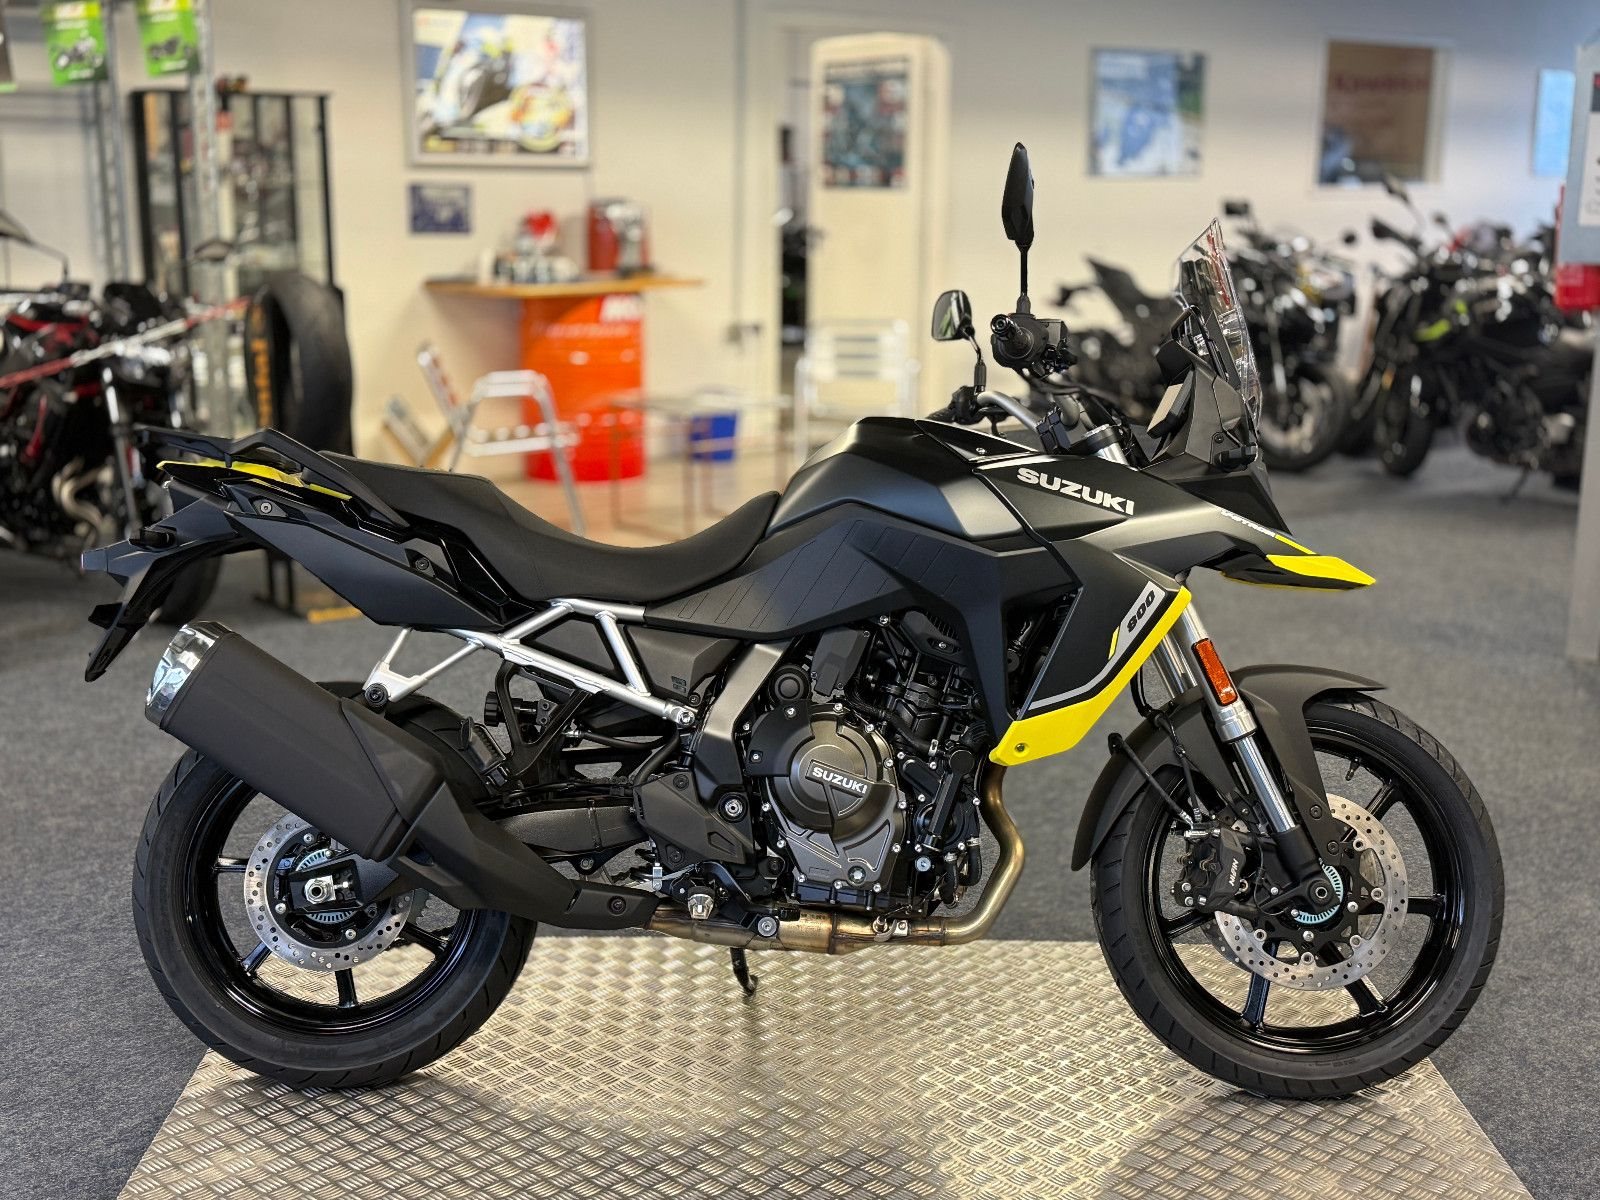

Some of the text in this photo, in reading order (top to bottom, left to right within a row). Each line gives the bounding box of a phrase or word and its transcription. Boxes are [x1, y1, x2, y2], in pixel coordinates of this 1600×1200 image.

[1017, 467, 1135, 516] SUZUKI
[1127, 590, 1155, 633] 800
[812, 767, 868, 794] SUZUKI
